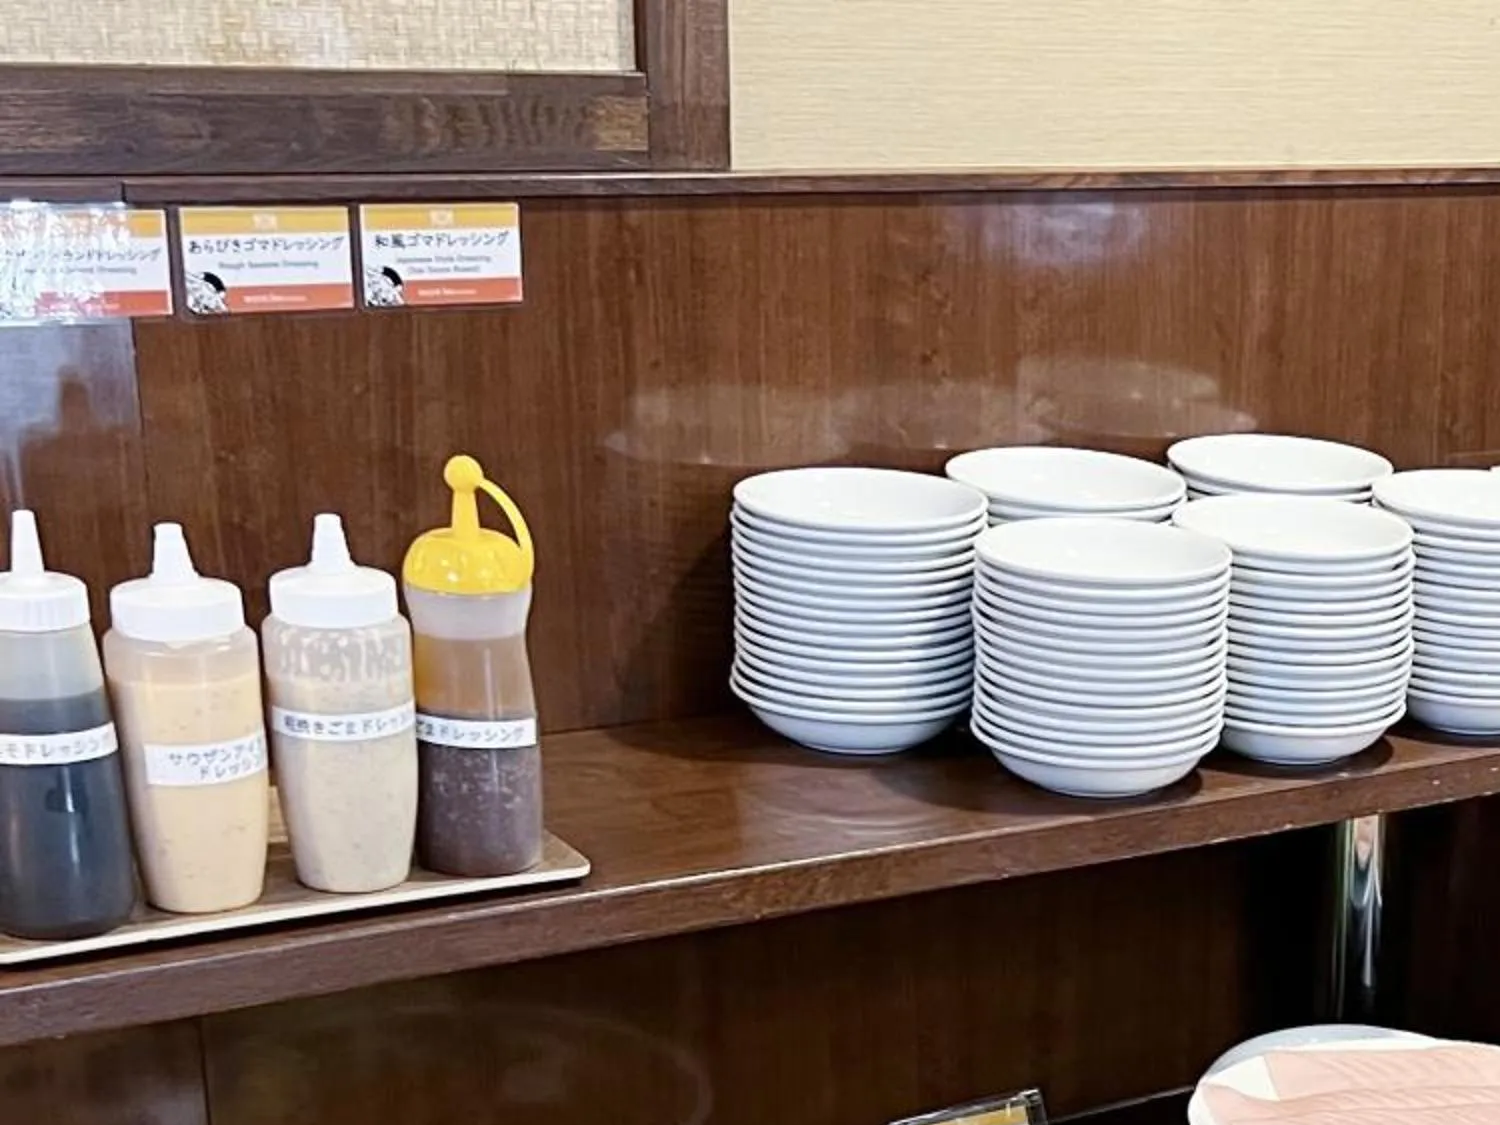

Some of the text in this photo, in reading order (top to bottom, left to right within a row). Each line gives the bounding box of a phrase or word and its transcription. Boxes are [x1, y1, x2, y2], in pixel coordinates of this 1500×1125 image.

[188, 236, 345, 254] あらびきゴマドレッシング
[375, 231, 510, 249] 和風ゴマドレッシング
